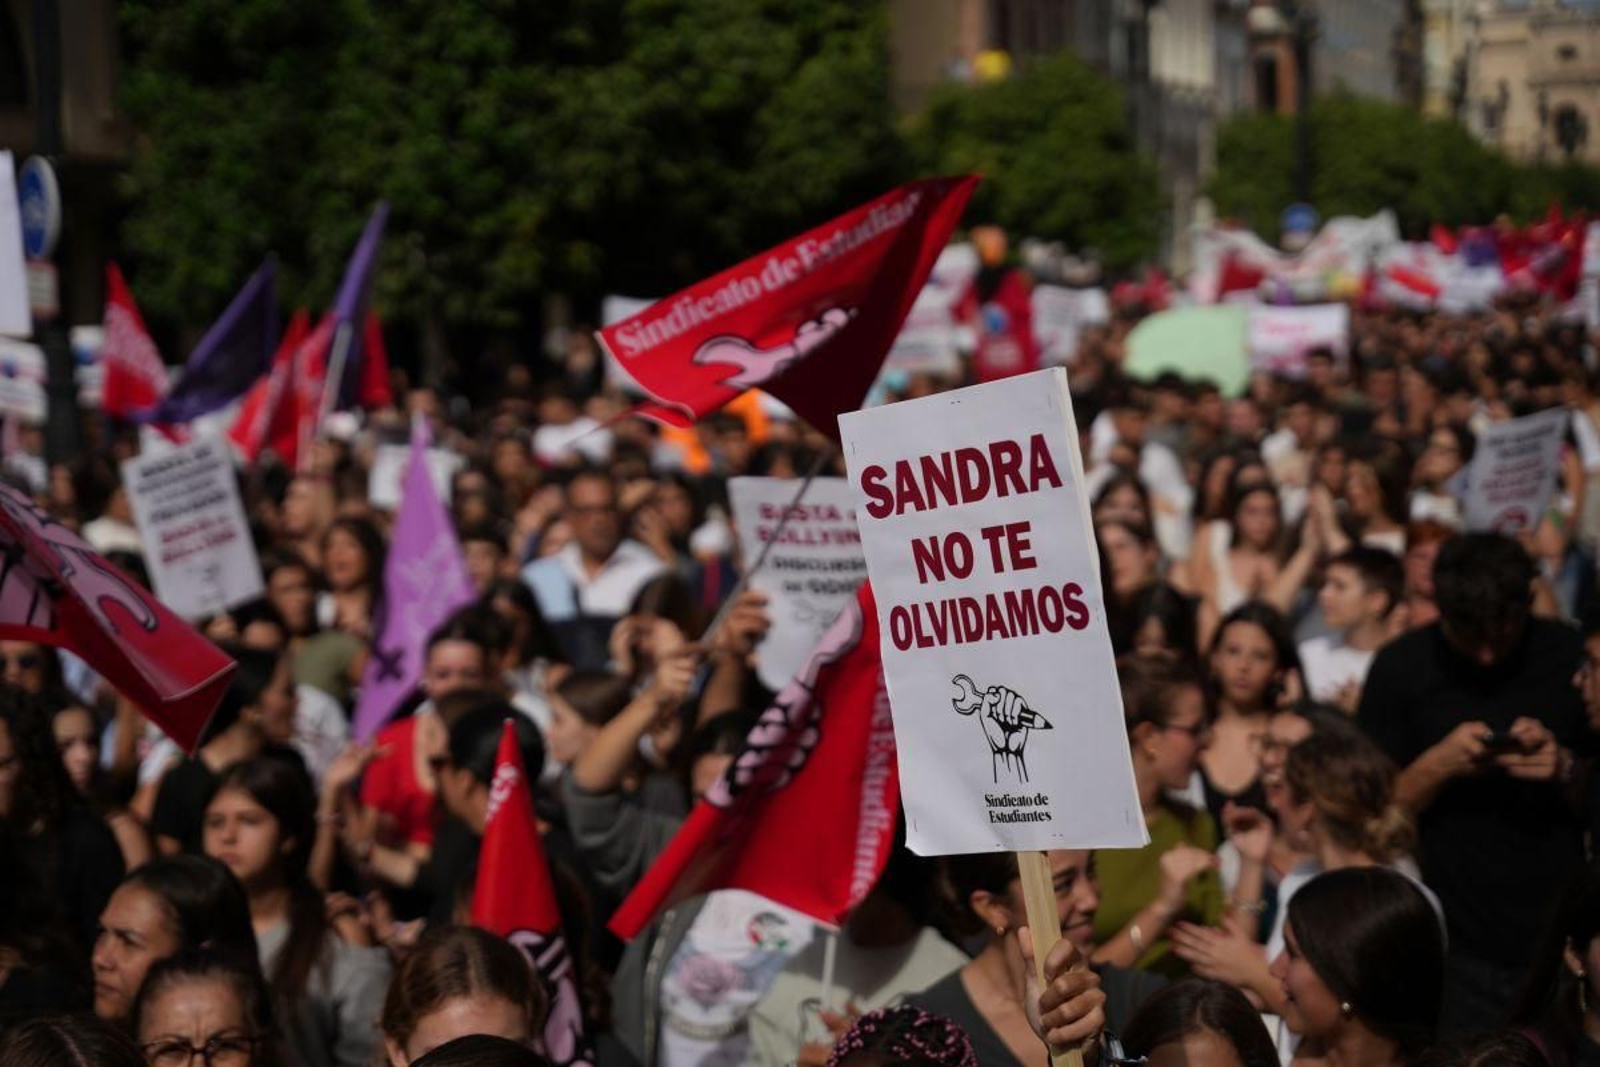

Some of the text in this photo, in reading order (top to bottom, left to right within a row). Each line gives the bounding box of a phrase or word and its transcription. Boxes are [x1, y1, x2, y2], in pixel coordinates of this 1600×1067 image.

[613, 271, 762, 358] Sindicato
[759, 254, 800, 298] de
[860, 433, 1063, 519] SANDRA
[757, 524, 861, 545] BULLYIN
[758, 503, 843, 521] BASTA
[911, 520, 1038, 584] NO TE
[889, 582, 1090, 651] OLVIDAMOS
[851, 730, 896, 902] Estudiante
[984, 792, 1049, 808] Sindicato de
[988, 809, 1053, 824] Estudiantes
